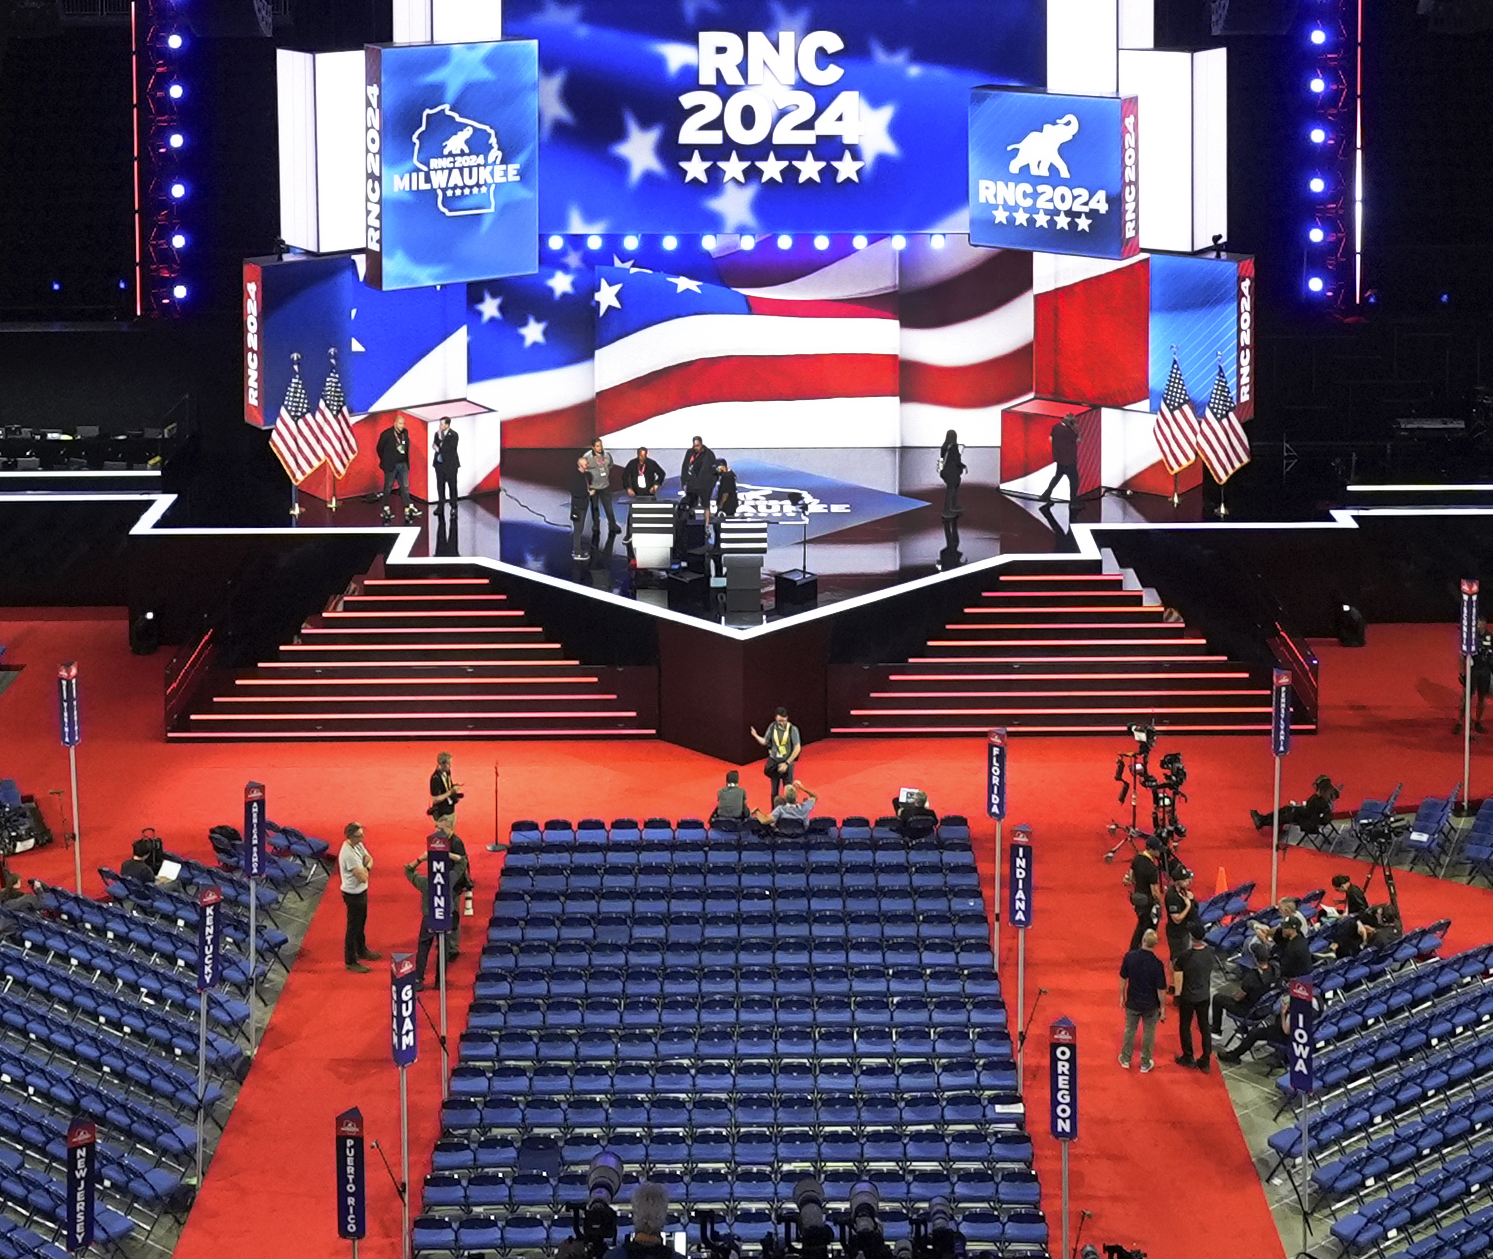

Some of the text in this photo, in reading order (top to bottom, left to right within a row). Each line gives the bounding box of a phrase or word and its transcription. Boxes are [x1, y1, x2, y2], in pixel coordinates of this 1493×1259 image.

[698, 30, 845, 86] RNC
[677, 90, 864, 145] 2024
[366, 83, 381, 252] RNC 2024
[393, 163, 521, 192] MILWAUKEE
[430, 154, 485, 170] RNC 2024
[978, 179, 1109, 214] RNC 2024
[1124, 114, 1136, 239] RNC 2024
[246, 281, 258, 407] RNC 2024
[1240, 277, 1251, 404] RNC 2024
[991, 747, 1000, 814] FLORIDA
[432, 861, 445, 920] MAINE
[1015, 847, 1026, 921] INDIANA
[203, 906, 214, 984] KENTUCKY
[401, 984, 415, 1051] GUAM
[1292, 1013, 1310, 1075] IOWA
[1055, 1046, 1071, 1133] OREGON
[74, 1146, 87, 1244] NEW JERSEY
[346, 1139, 357, 1233] PUERTO RICO
